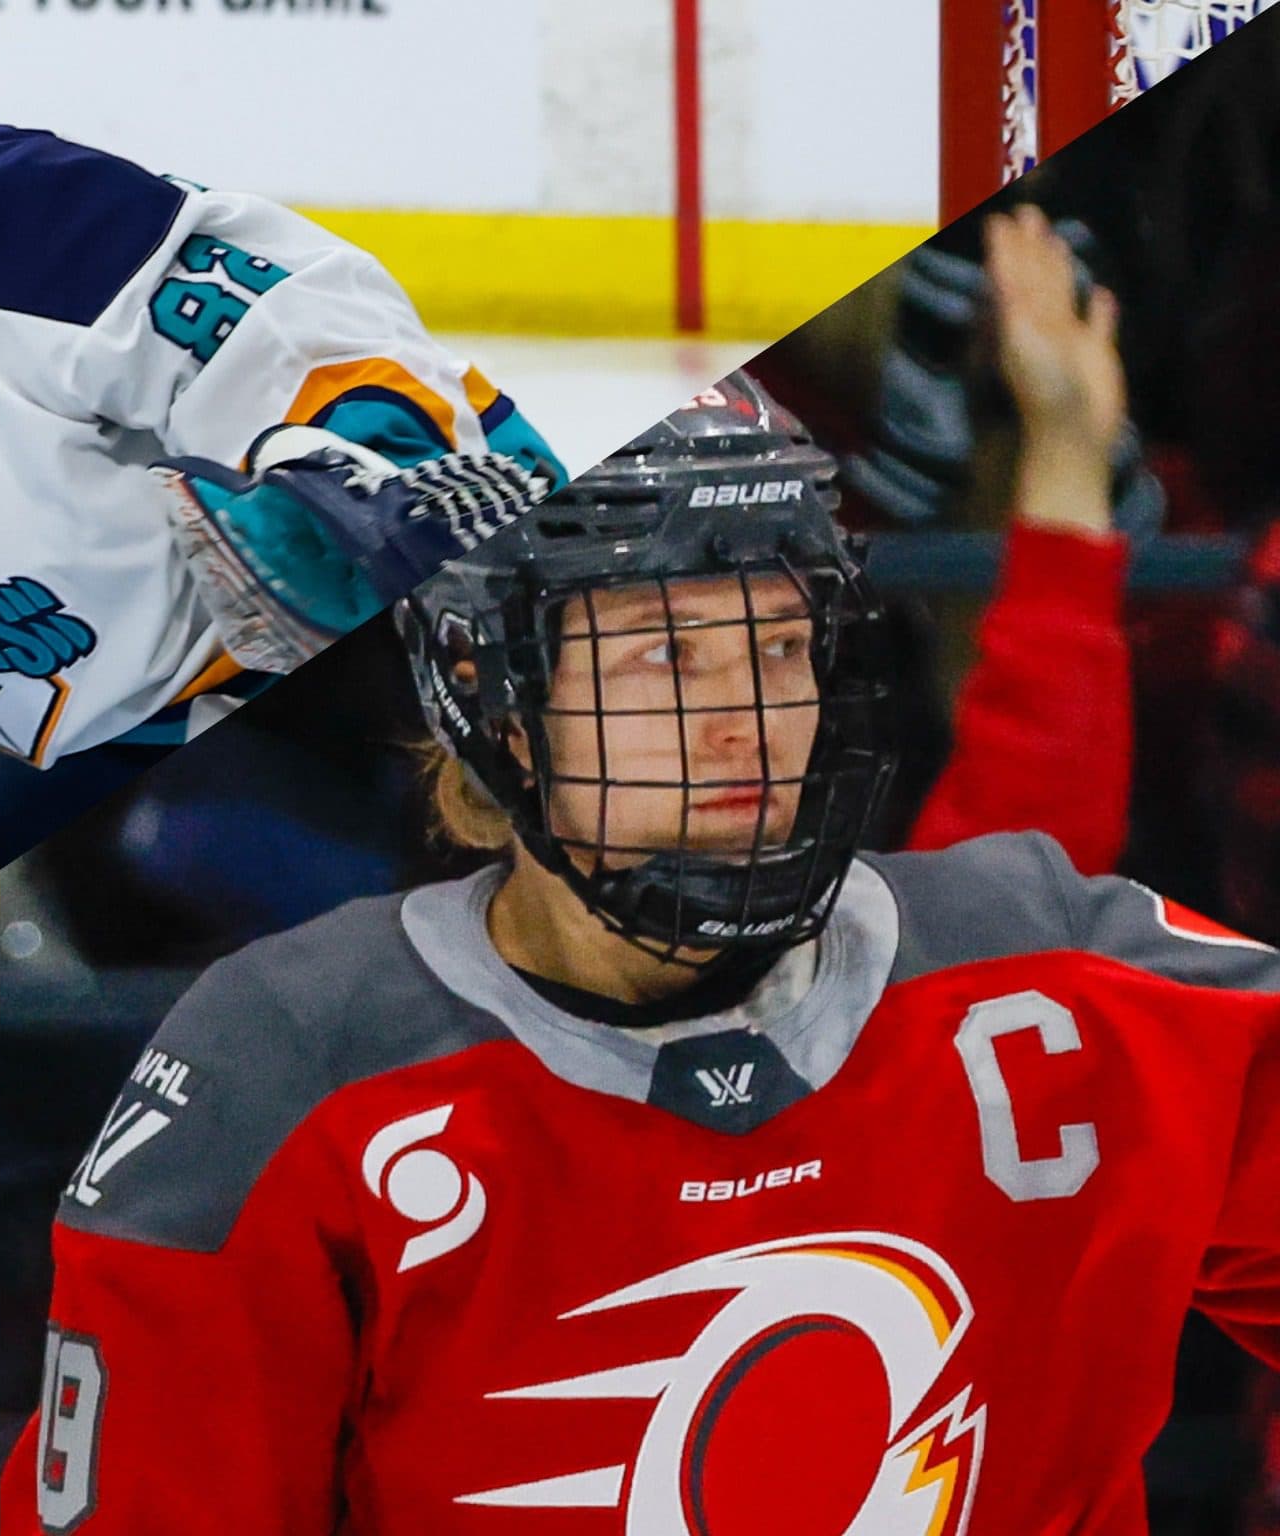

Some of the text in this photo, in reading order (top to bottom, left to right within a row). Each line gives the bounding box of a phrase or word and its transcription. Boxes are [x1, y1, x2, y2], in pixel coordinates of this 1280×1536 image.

[687, 480, 805, 508] BAUER
[953, 989, 1100, 1202] C
[678, 1158, 822, 1202] BAUER
